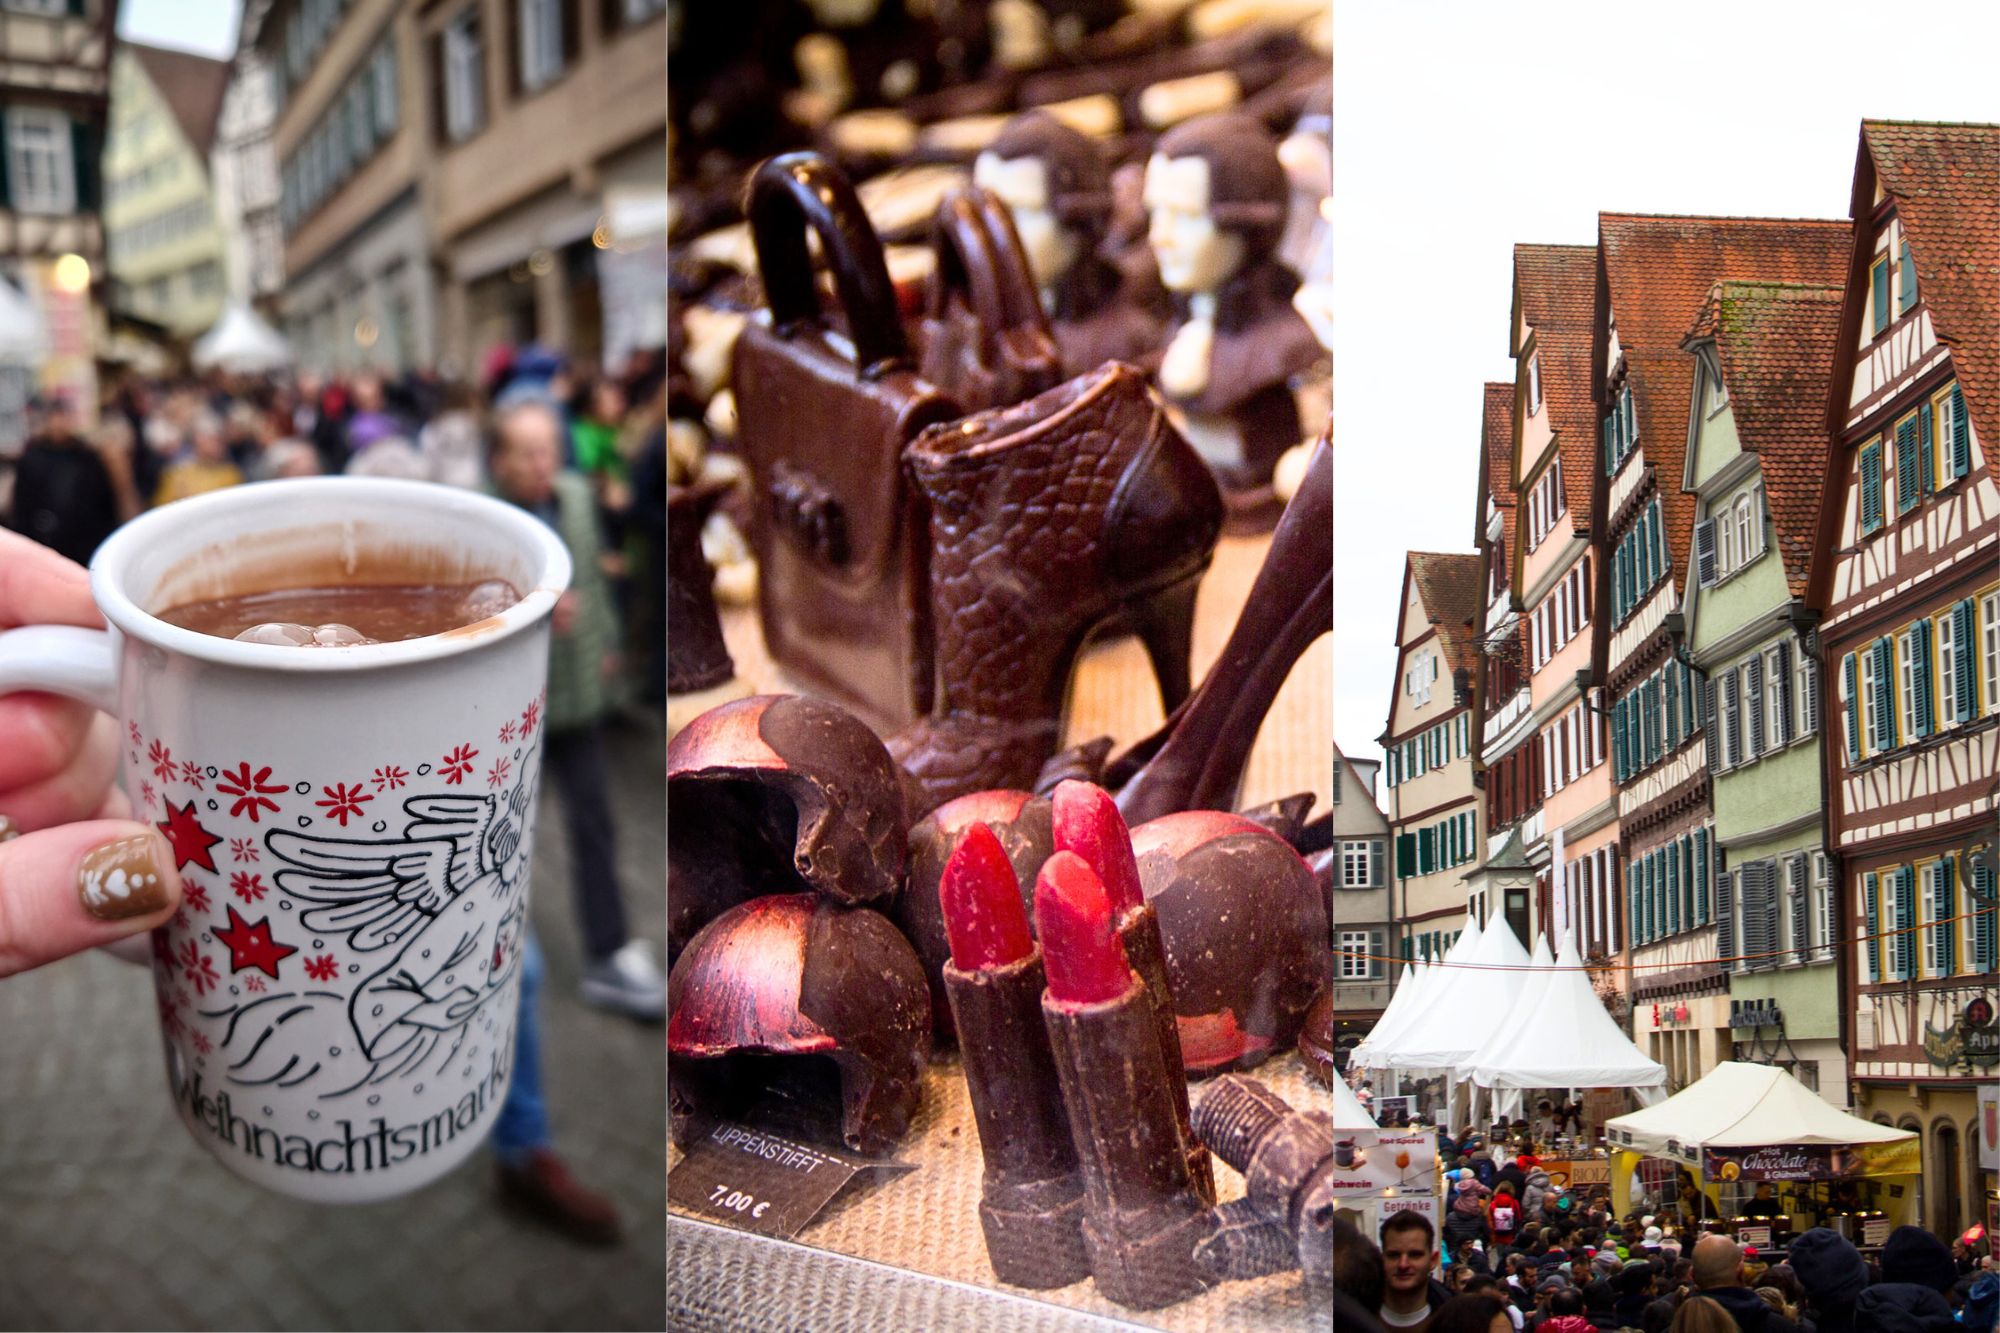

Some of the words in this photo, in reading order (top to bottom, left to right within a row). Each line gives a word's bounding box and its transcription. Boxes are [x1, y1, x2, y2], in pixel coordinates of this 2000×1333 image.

[711, 1124, 823, 1174] LIPPENSTIFFT
[1742, 1151, 1808, 1170] Chocolate
[709, 1184, 752, 1211] 7,00
[753, 1201, 770, 1218] €
